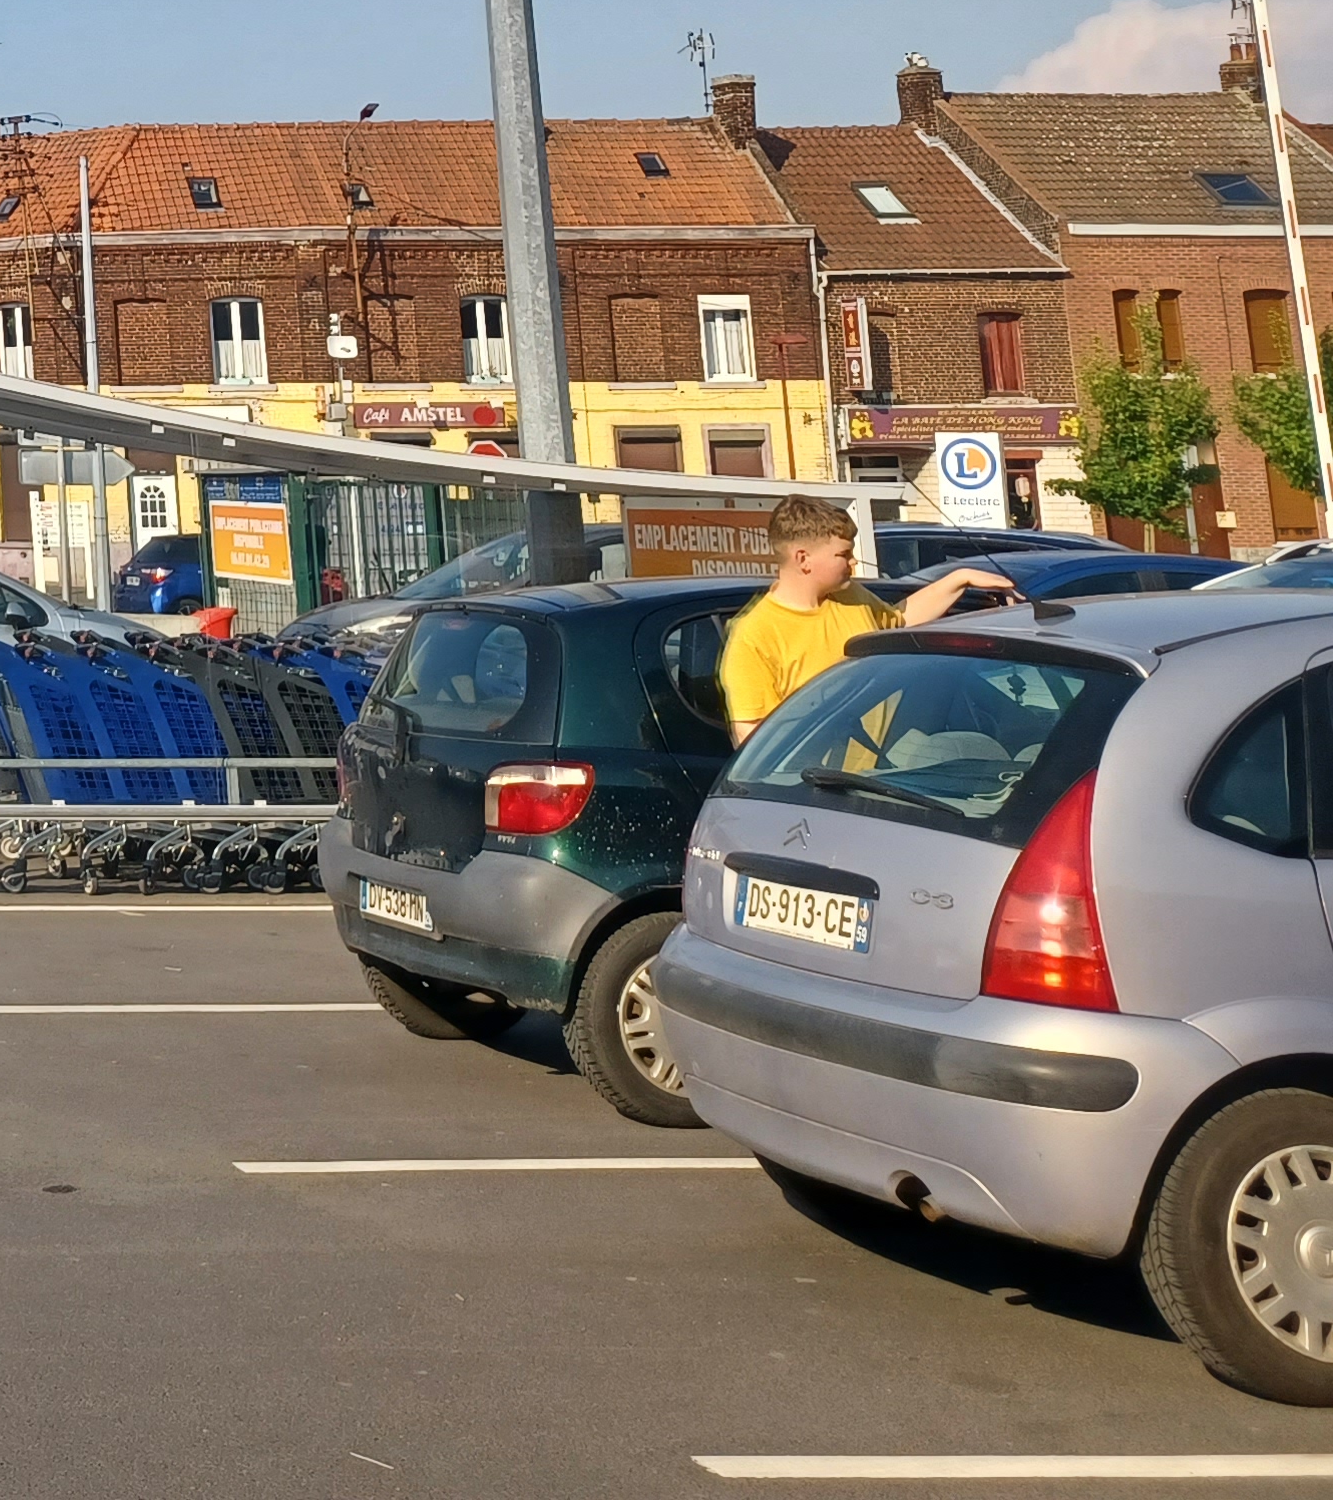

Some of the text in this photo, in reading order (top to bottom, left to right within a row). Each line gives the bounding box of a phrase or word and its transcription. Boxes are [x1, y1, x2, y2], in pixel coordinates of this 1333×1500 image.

[400, 406, 466, 423] AMSTEL
[945, 416, 966, 425] DE
[968, 415, 1006, 425] HONG
[1007, 415, 1044, 425] KONG
[634, 523, 776, 555] EMPLACEMENT PUB
[748, 883, 855, 938] DS-913-CE
[855, 925, 868, 944] 59
